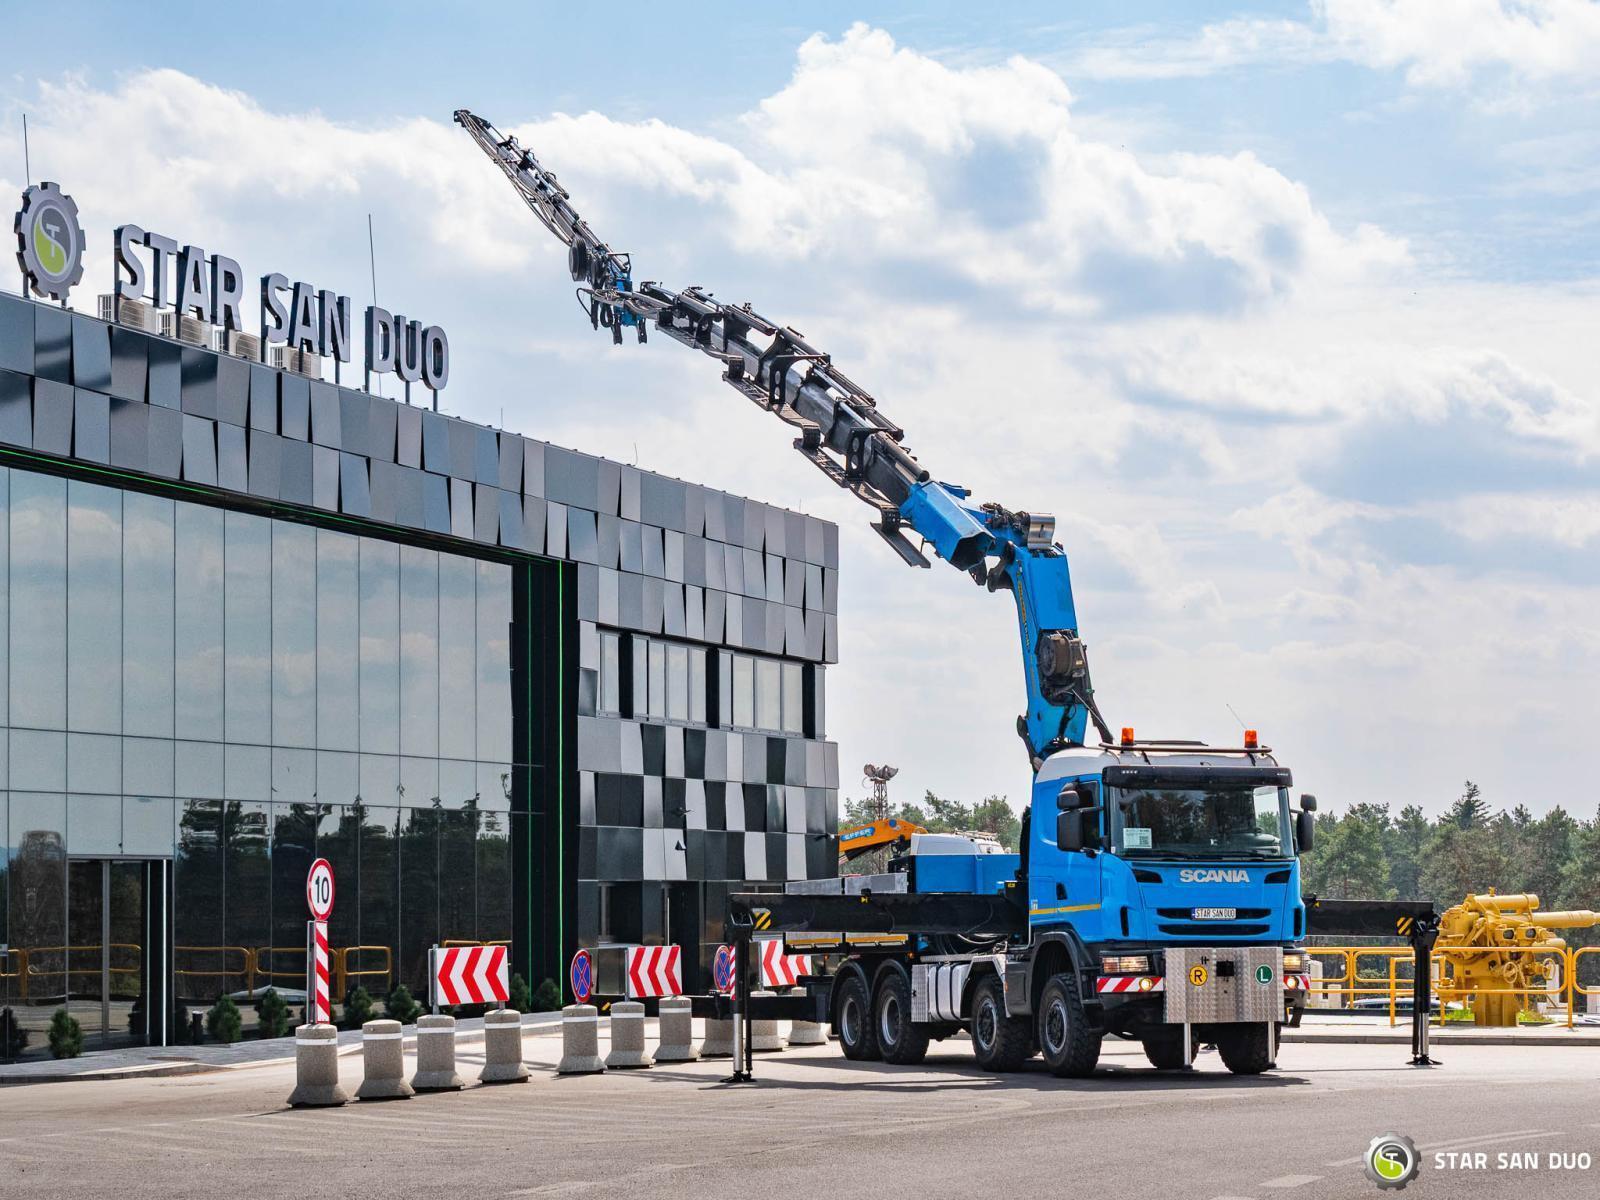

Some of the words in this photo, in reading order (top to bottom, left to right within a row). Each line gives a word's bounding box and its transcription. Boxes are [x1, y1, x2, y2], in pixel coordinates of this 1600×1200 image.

[115, 224, 244, 332] STAR
[261, 272, 351, 363] SAN
[365, 306, 449, 390] DUO
[1180, 869, 1250, 883] SCANIA
[315, 875, 330, 904] 10
[1195, 908, 1211, 918] STAR
[1194, 970, 1203, 982] R
[1260, 968, 1268, 982] L
